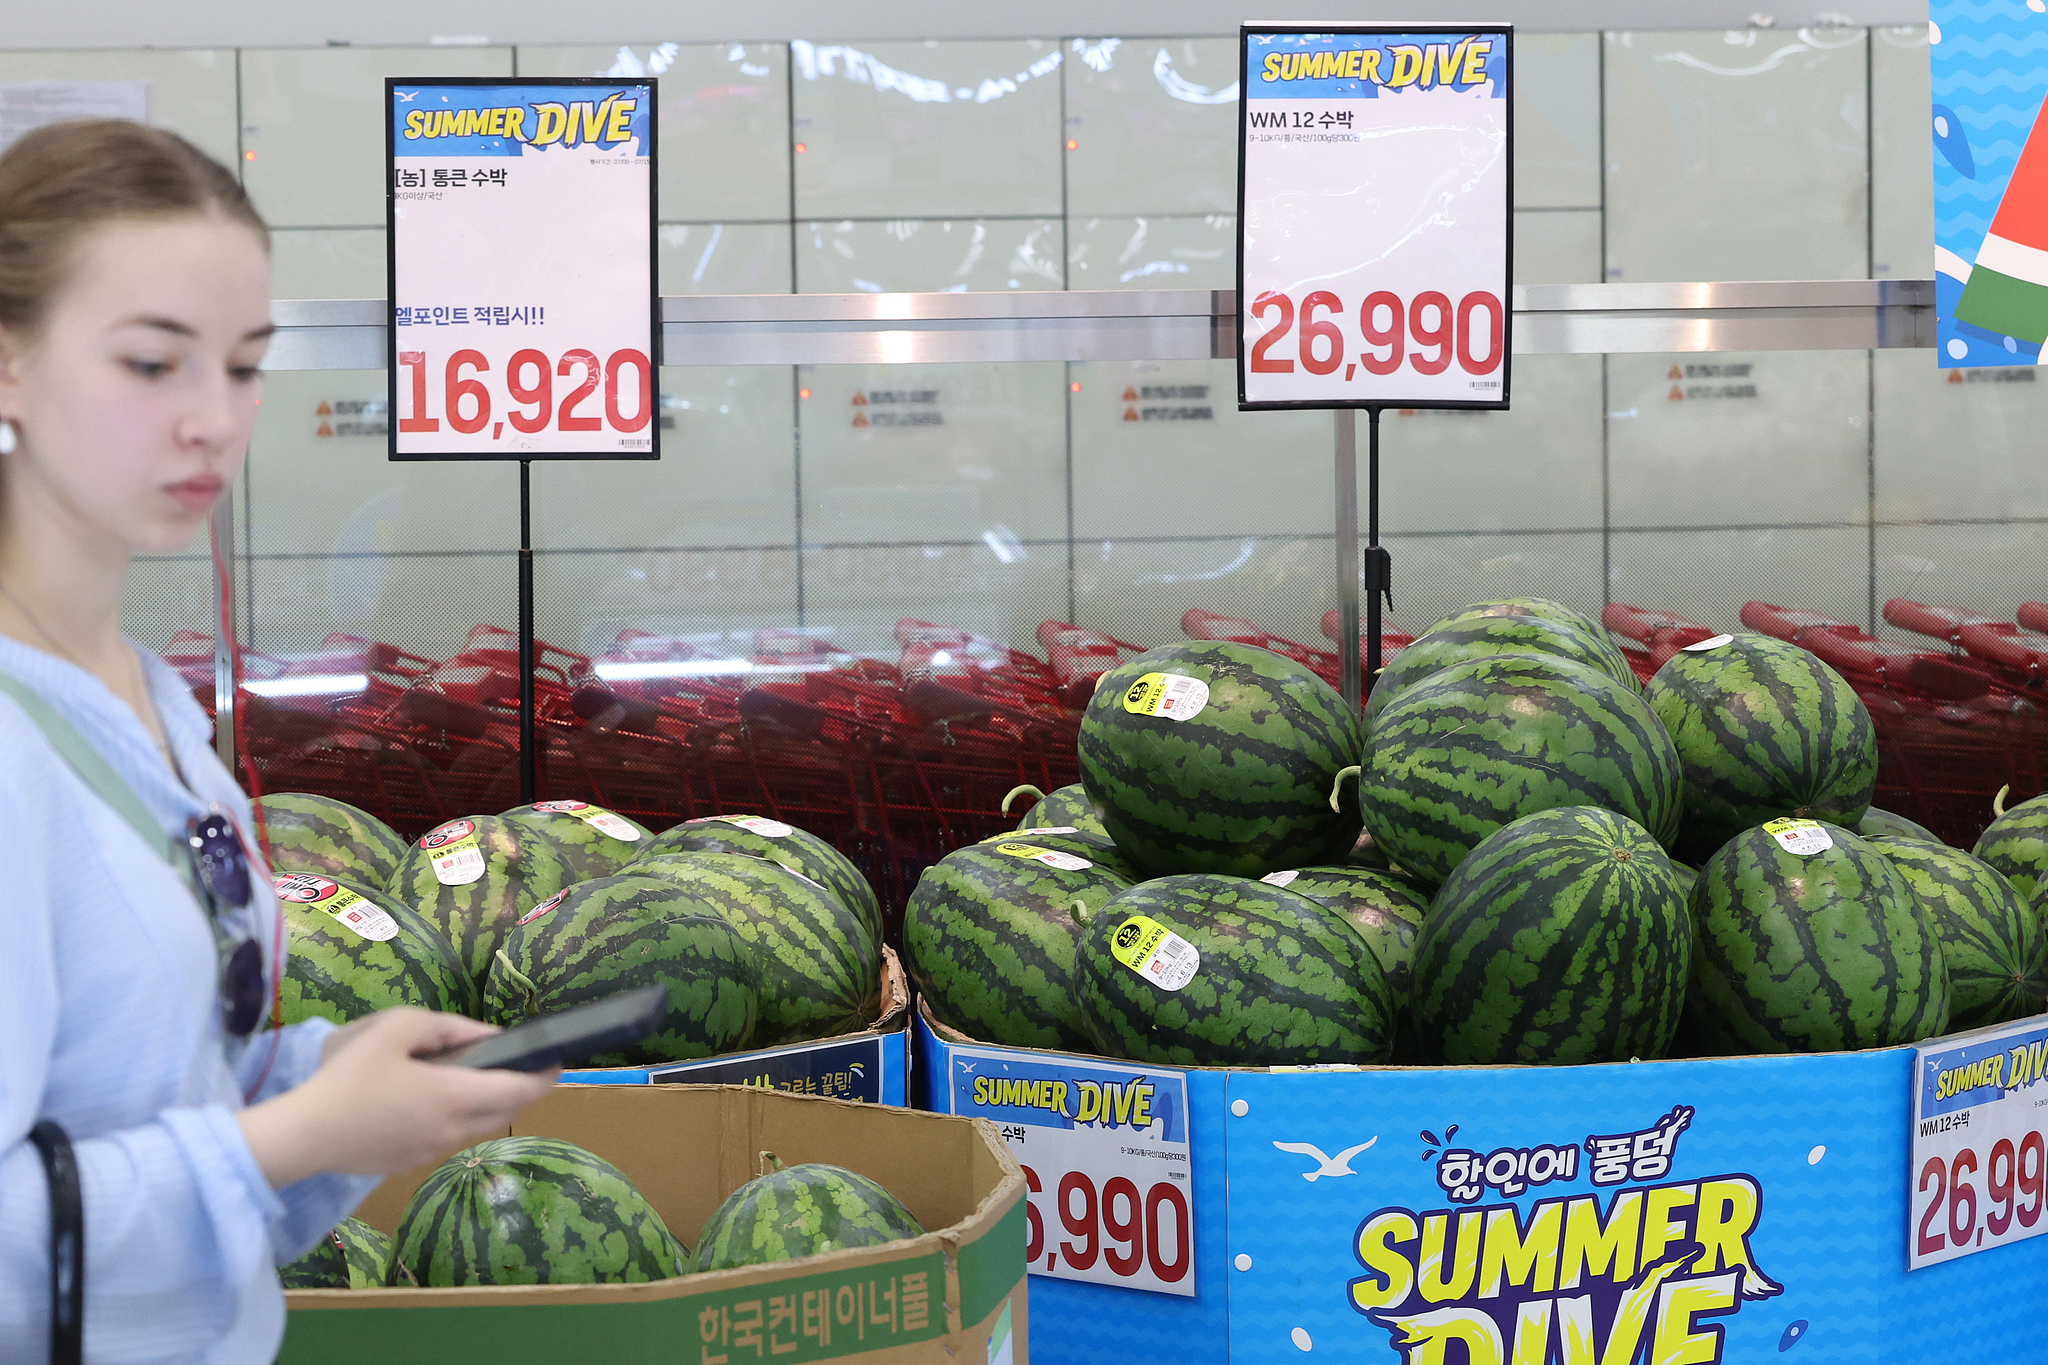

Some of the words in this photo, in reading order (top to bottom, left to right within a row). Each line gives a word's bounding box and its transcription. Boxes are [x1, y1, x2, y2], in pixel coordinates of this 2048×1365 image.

[1262, 50, 1387, 84] SUMMER
[1386, 36, 1491, 89] DIVE
[404, 107, 527, 142] SUMMER
[529, 92, 637, 146] DIVE
[1250, 112, 1287, 128] WM
[1293, 112, 1314, 128] 12
[1318, 111, 1354, 129] 수박
[395, 169, 425, 187] [농]
[432, 169, 468, 187] 통큰
[471, 168, 507, 187] 수박
[395, 307, 470, 326] 엘포인트
[474, 306, 545, 326] 적립시!!
[1250, 291, 1504, 381] 26,990
[399, 348, 652, 440] 16,920
[1119, 928, 1132, 943] 12
[1132, 952, 1146, 967] WM
[1143, 941, 1154, 952] 12
[1151, 928, 1165, 943] 수박
[821, 1071, 853, 1095] 꿀팁!
[1935, 1053, 2005, 1102] SUMMER
[2007, 1038, 2048, 1091] DIV
[974, 1076, 1072, 1118] SUMMER
[1073, 1076, 1155, 1127] DIVE
[1920, 1120, 1938, 1137] WM
[1940, 1116, 1951, 1132] 12
[1952, 1110, 1970, 1130] 수박
[1002, 1126, 1026, 1143] 수박
[1441, 1148, 1578, 1200] 할인에
[1594, 1112, 1686, 1182] 풍덩
[1918, 1131, 2048, 1256] 26,99
[1352, 1178, 1779, 1311] SUMMER
[698, 1272, 929, 1365] 한국컨테이너풀
